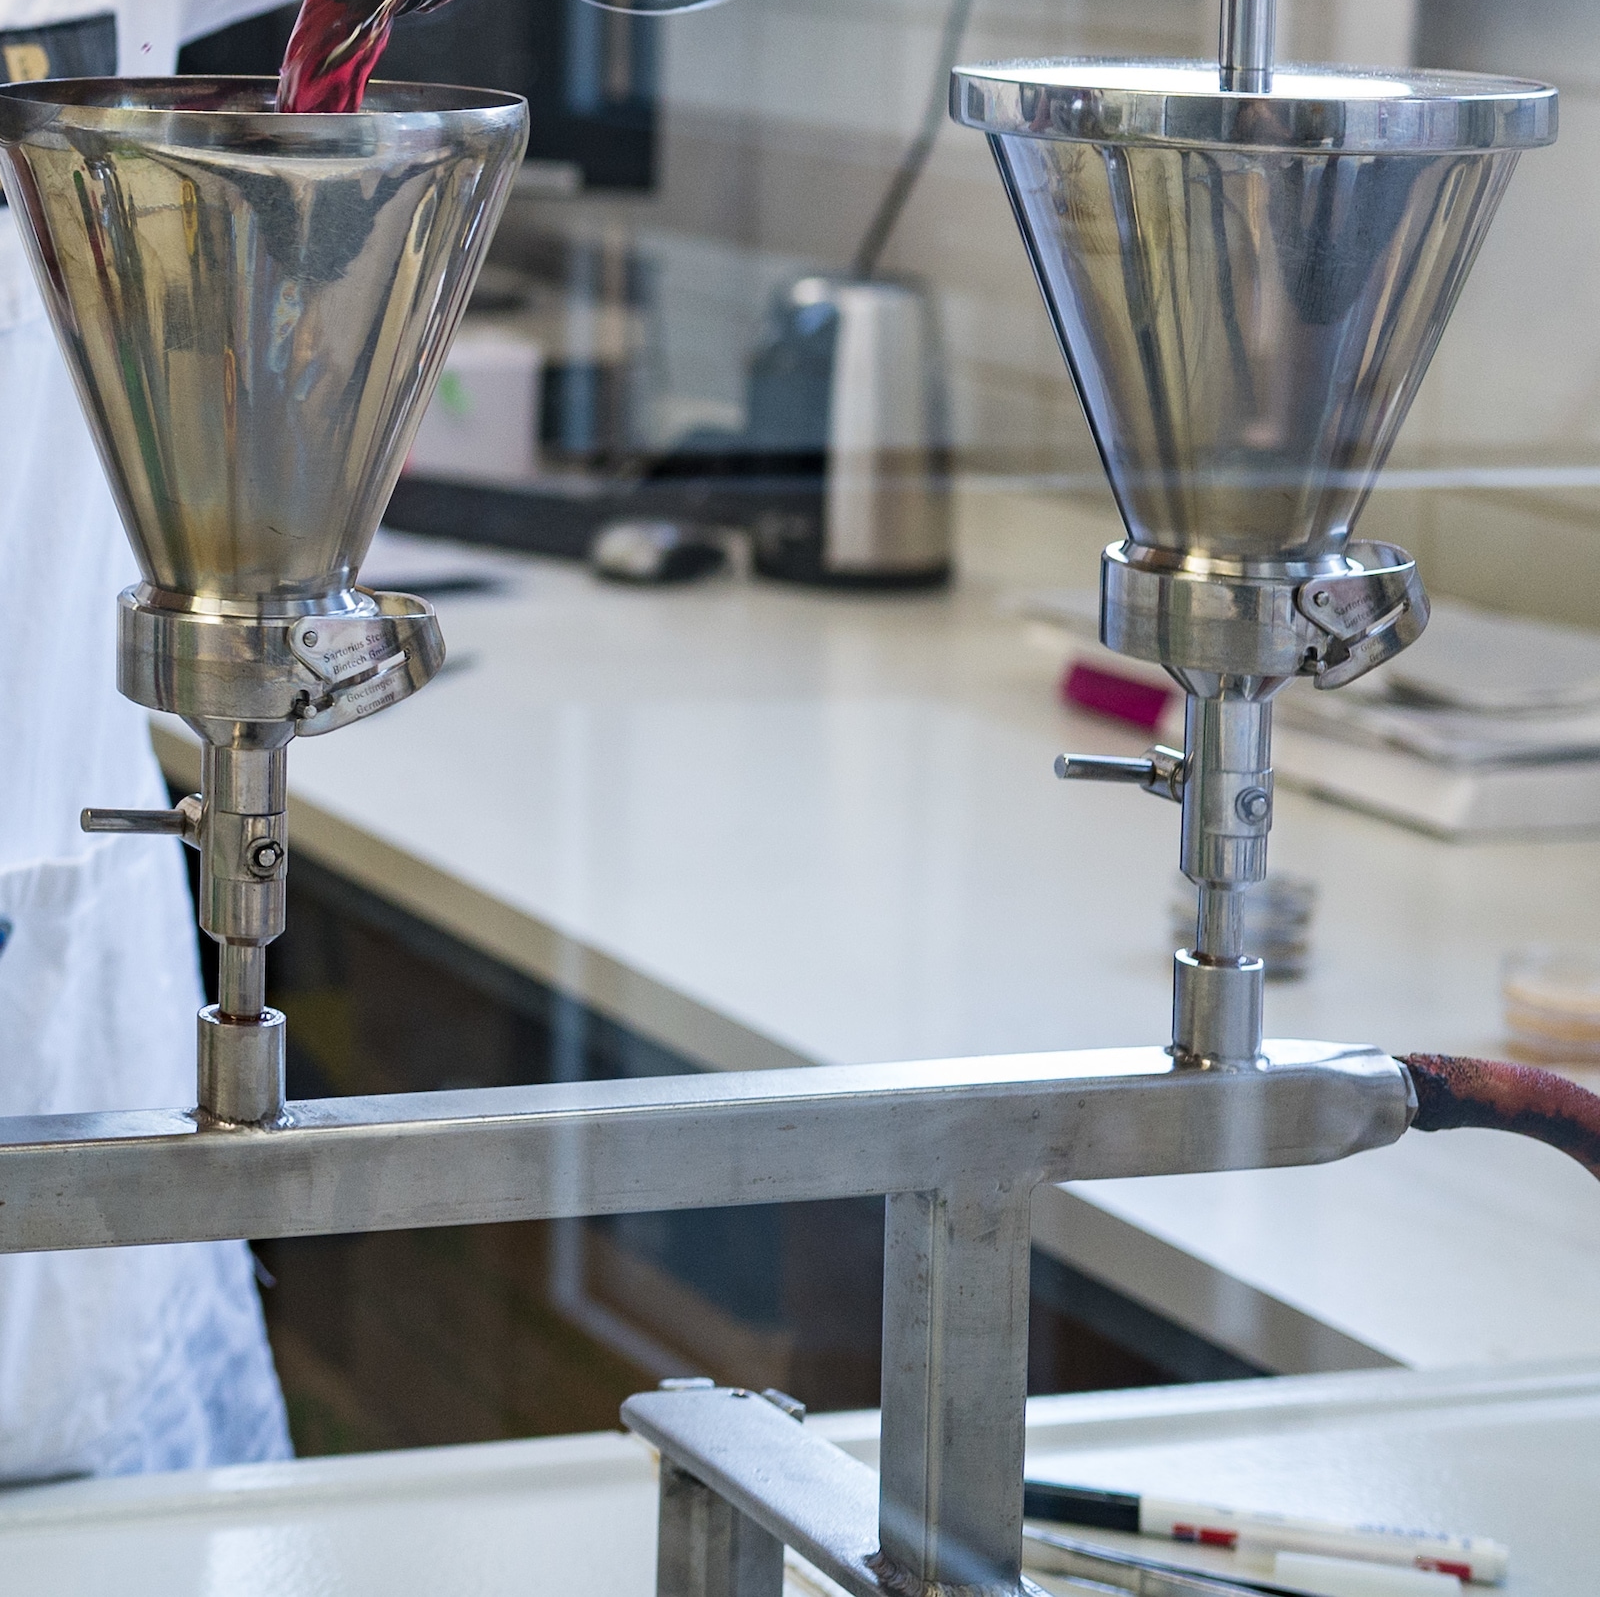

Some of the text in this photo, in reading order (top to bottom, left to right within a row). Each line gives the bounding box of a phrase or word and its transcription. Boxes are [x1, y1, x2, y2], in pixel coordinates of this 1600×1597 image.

[1333, 594, 1375, 616] Sartoriu
[323, 640, 365, 663] Sartorius
[332, 655, 367, 675] Biotech
[346, 674, 397, 703] Goettingen
[356, 692, 396, 715] Germany
